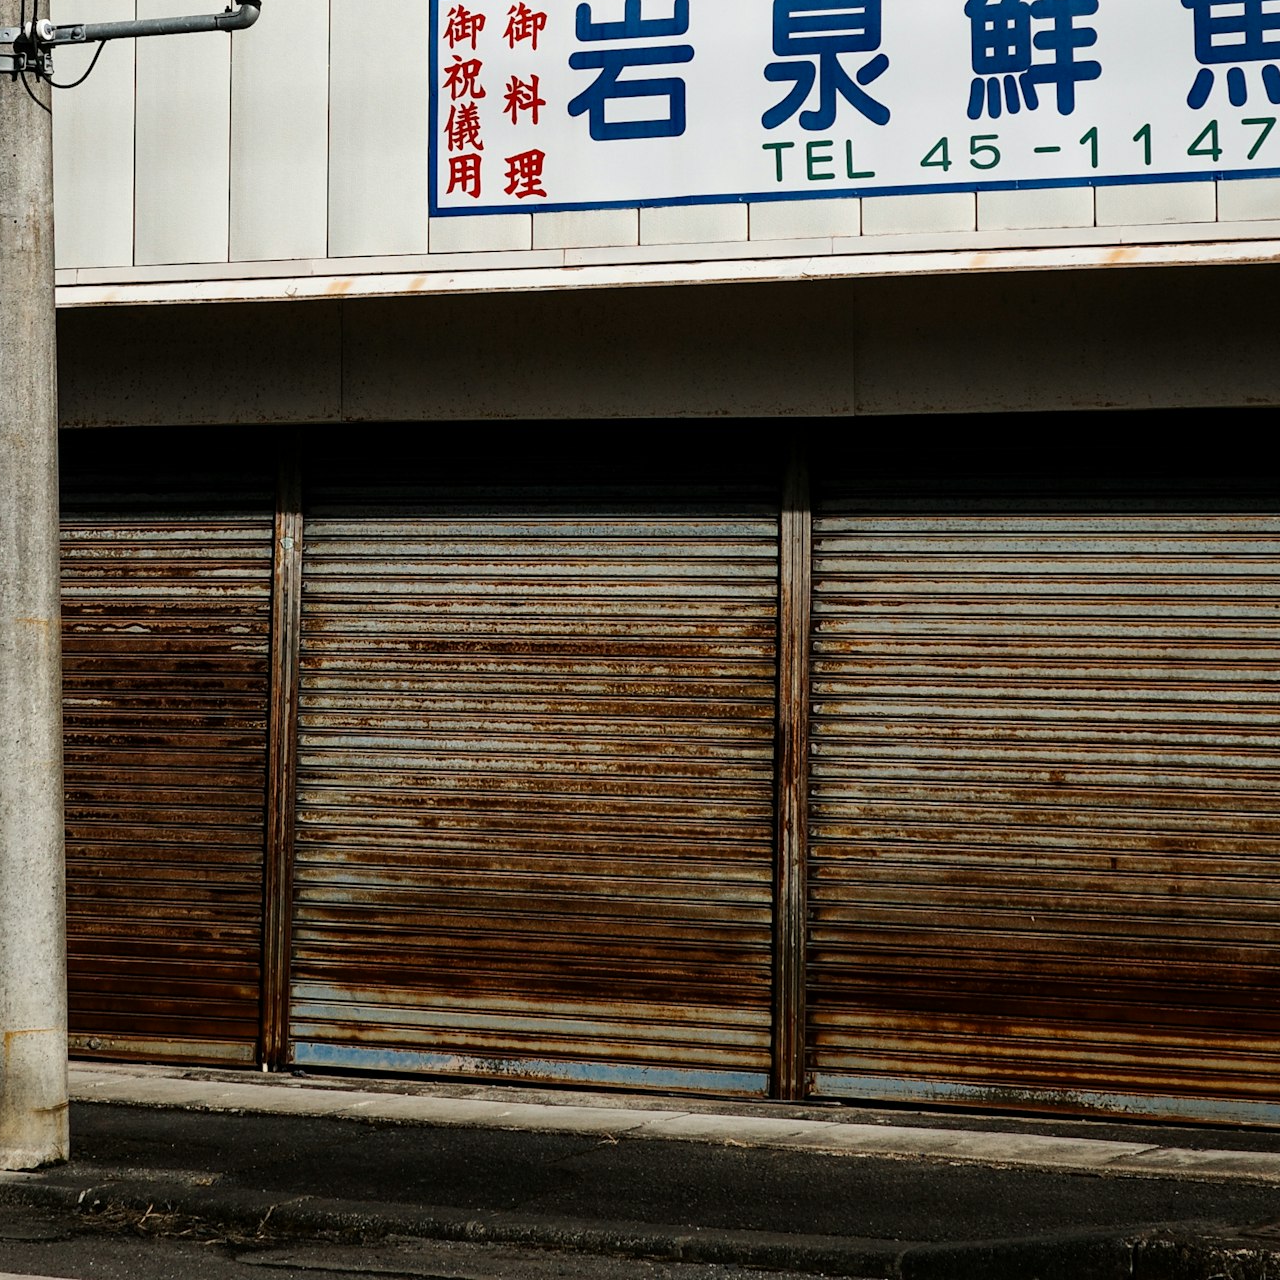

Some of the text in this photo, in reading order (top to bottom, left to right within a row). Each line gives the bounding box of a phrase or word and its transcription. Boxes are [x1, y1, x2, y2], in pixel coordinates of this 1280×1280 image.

[444, 4, 487, 199] 御祝儀用
[502, 1, 548, 199] 御料理
[761, 116, 1276, 182] TEL 45-1147
